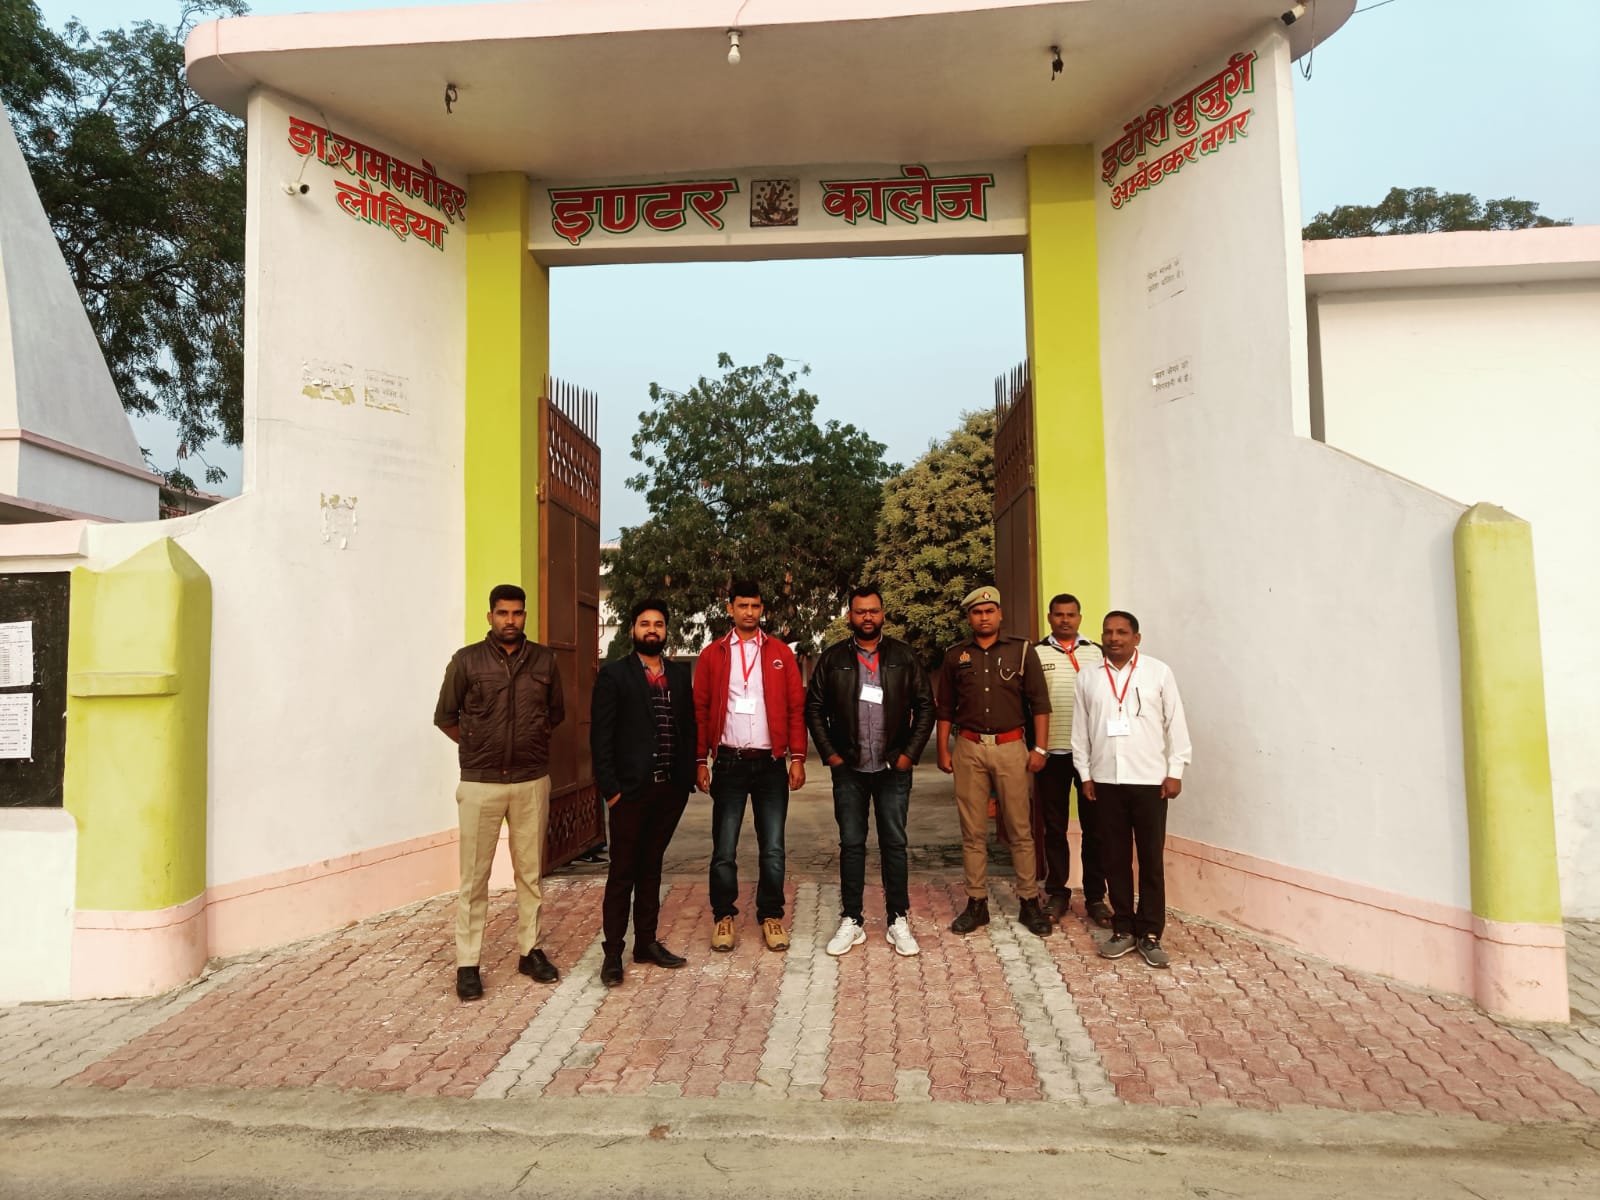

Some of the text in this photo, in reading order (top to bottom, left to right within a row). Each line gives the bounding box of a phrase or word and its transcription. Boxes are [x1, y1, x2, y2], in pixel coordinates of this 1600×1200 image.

[1171, 50, 1258, 136] बुजुर्ग
[1110, 108, 1255, 209] अम्बेडकर नगर
[333, 179, 448, 252] लोहिया
[547, 164, 995, 246] इण्टर कालेज
